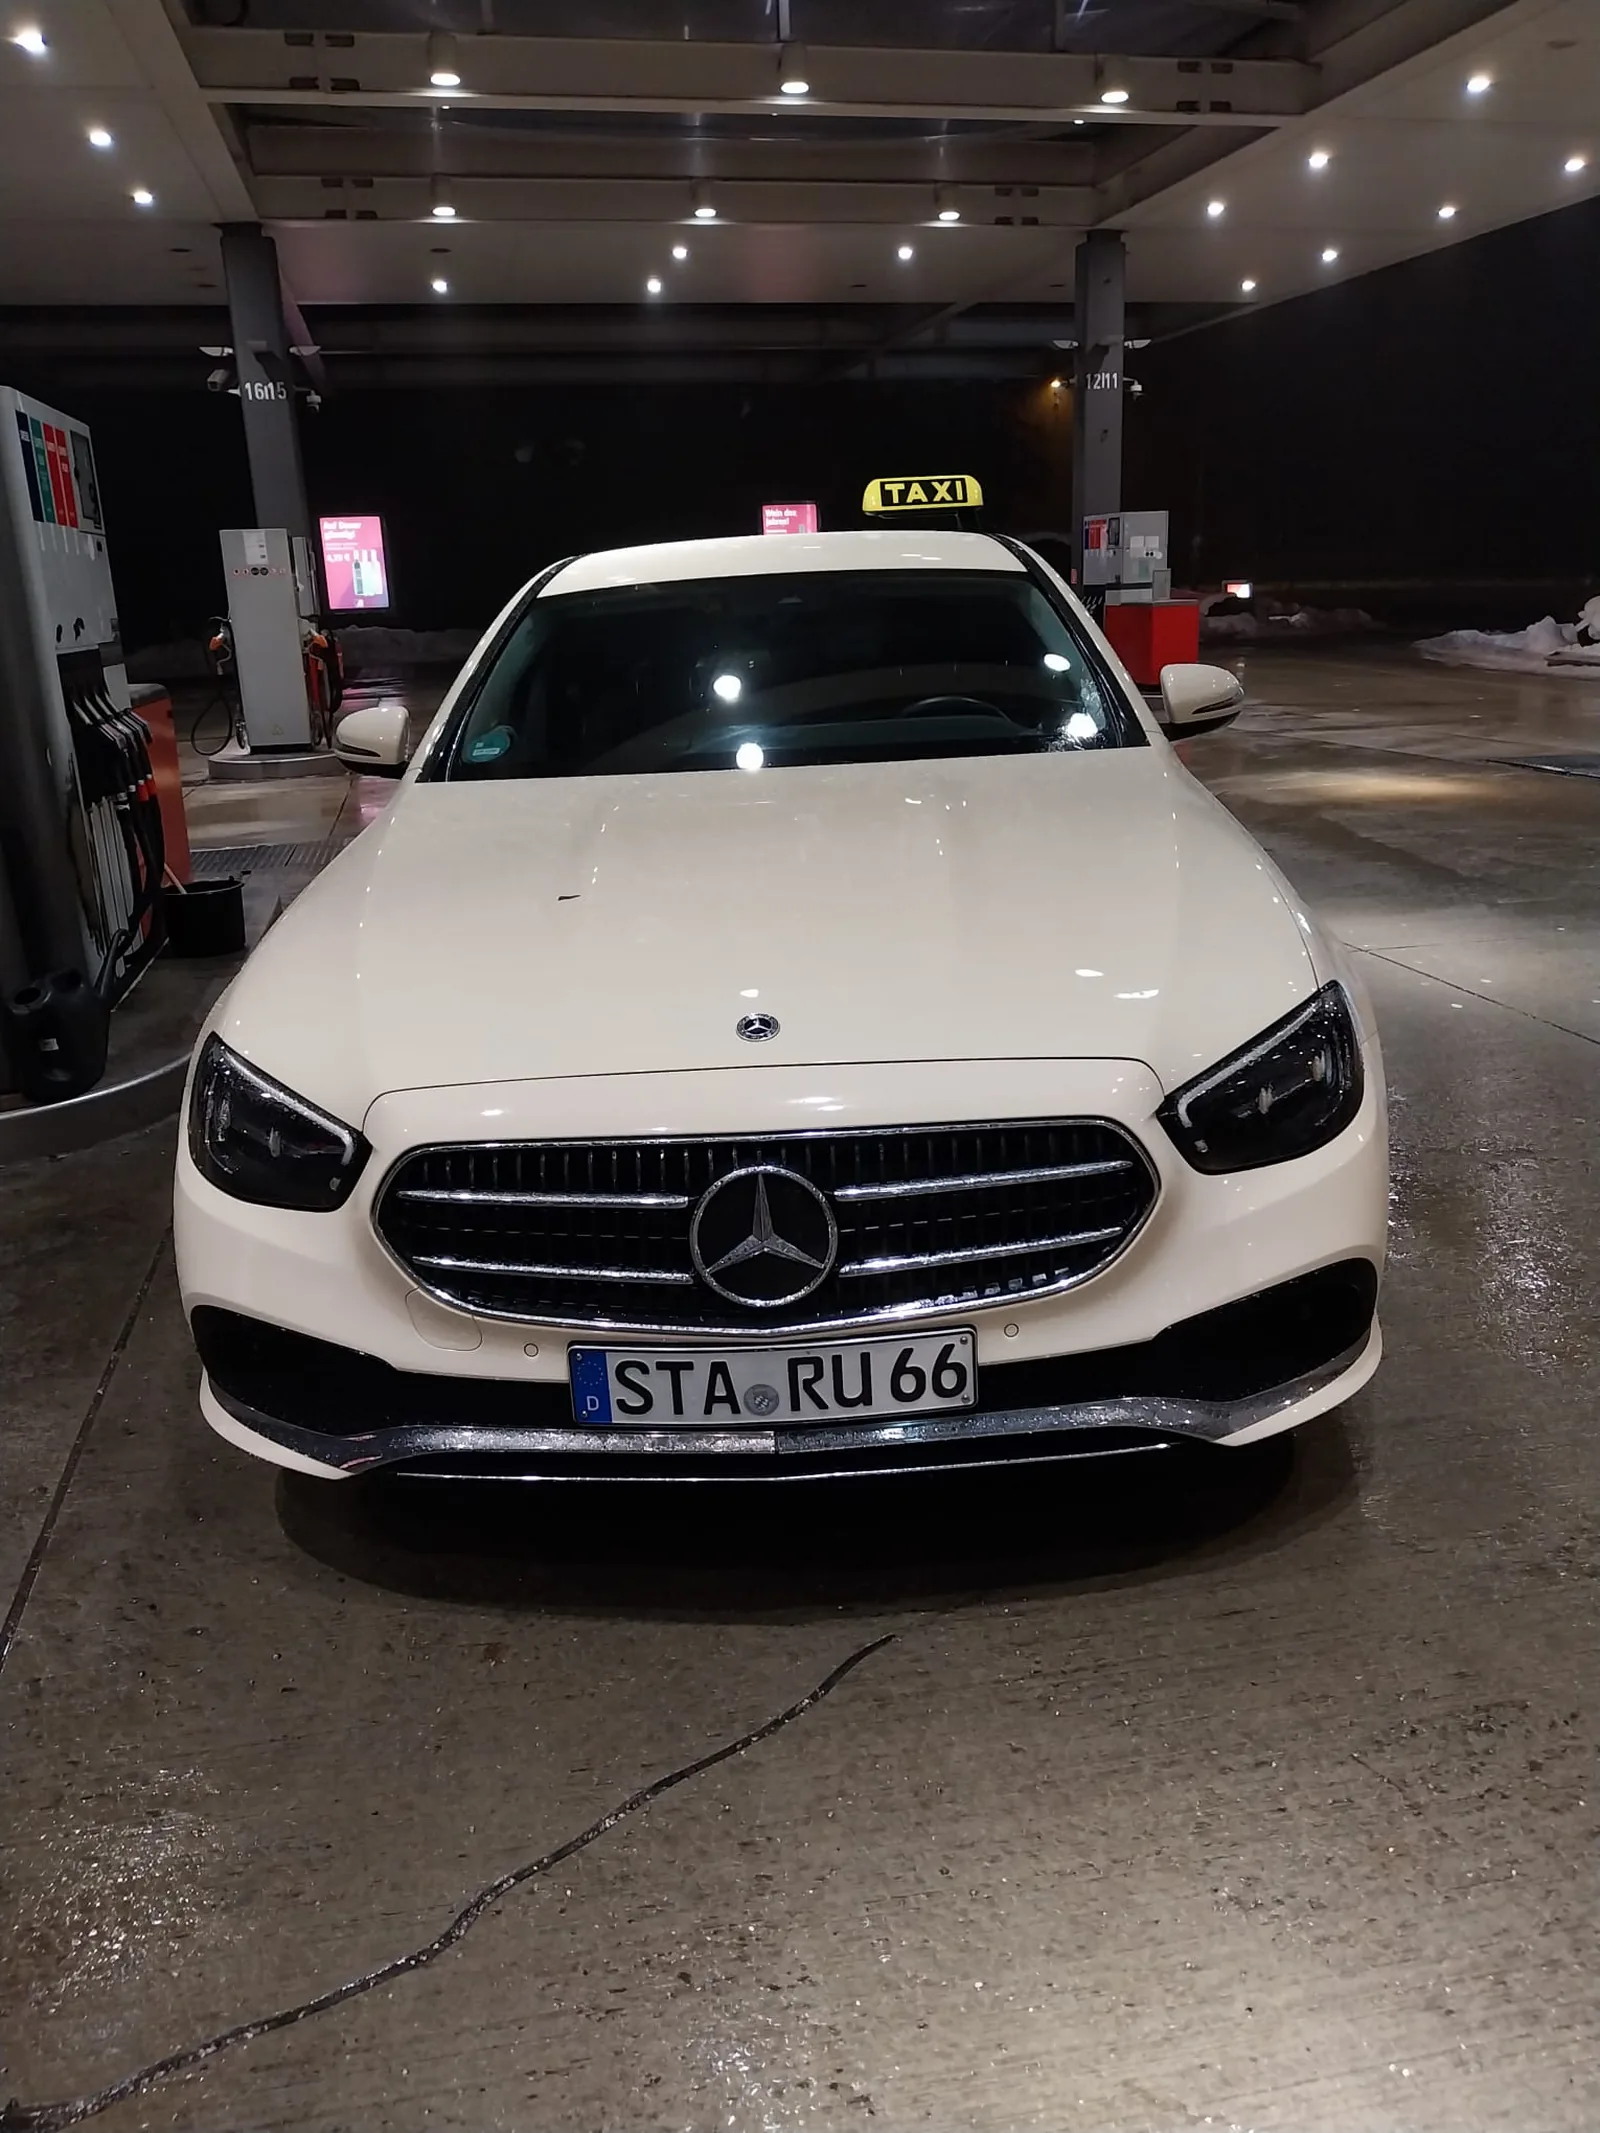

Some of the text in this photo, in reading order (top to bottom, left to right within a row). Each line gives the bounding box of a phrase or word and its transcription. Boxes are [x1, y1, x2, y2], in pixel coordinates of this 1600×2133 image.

[884, 480, 963, 504] TAXI
[586, 1342, 968, 1416] D STA RU 66
